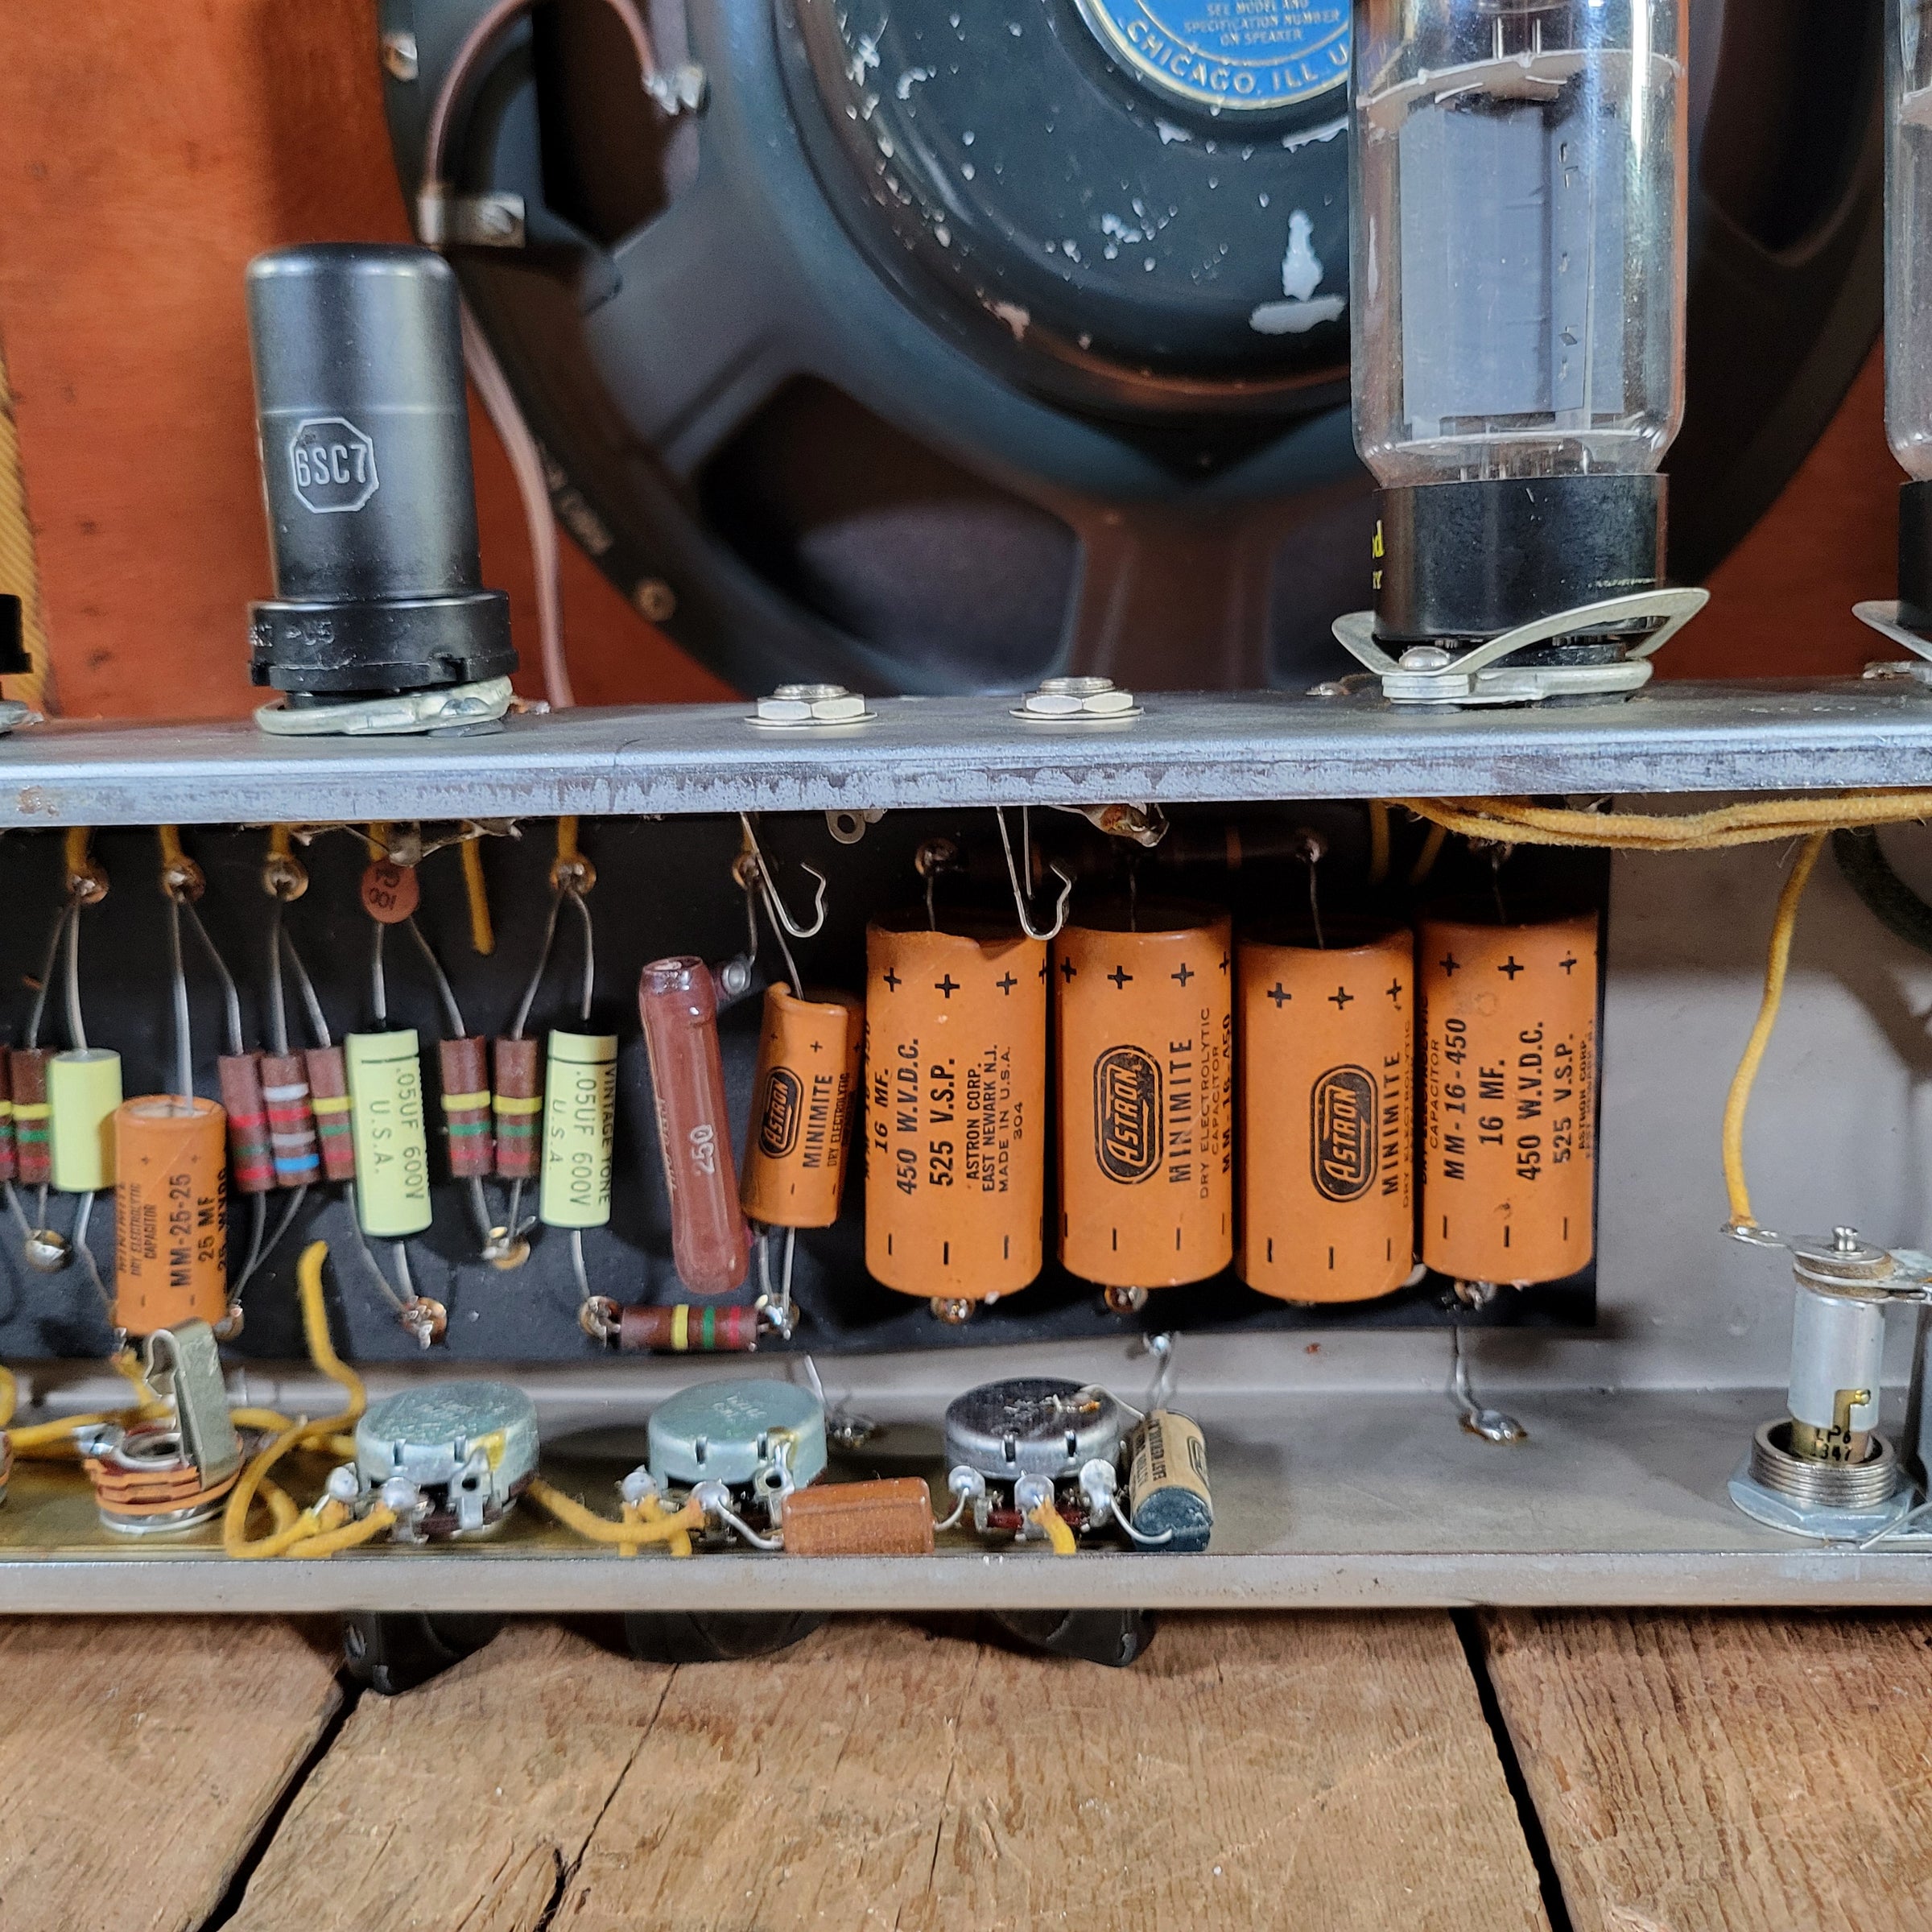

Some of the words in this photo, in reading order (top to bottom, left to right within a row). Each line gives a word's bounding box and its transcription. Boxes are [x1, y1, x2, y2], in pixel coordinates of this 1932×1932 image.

[1220, 33, 1240, 46] ON
[1244, 28, 1302, 43] SPEAKER
[1285, 8, 1340, 25] NUMBER
[295, 444, 368, 488] 6SC7
[874, 1068, 889, 1108] MF.
[897, 1038, 919, 1133] W.V.D.C.
[930, 1058, 956, 1124] V.S.P.
[967, 1063, 982, 1111] CORP.
[1200, 1007, 1211, 1152] ELECTROLYTIC
[1430, 1038, 1439, 1150] CAPACITOR
[1479, 1059, 1505, 1100] MF.
[1517, 1021, 1544, 1120] W.V.D.C.
[1554, 1034, 1574, 1102] V.S.P.
[764, 1077, 793, 1150] ASTRON
[803, 1075, 833, 1167] MINIMITE
[831, 1072, 850, 1144] ELECTROLYTIC
[982, 1080, 997, 1146] NEWARK
[999, 1110, 1009, 1131] IN
[1013, 1101, 1023, 1141] 304
[1106, 1063, 1150, 1168] ASTRON
[1169, 1038, 1192, 1184] MINIMITE
[1212, 1046, 1220, 1156] CAPACITOR
[1381, 1051, 1401, 1196] MINIMITE
[1578, 1090, 1587, 1150] ASTRON
[875, 1120, 889, 1154] 16
[966, 1118, 980, 1180] ASTRON
[1323, 1084, 1369, 1184] ASTRON
[1478, 1116, 1504, 1146] 16
[1516, 1134, 1542, 1181] 450
[1553, 1117, 1571, 1164] 525
[402, 1146, 425, 1199] 600V
[569, 1151, 593, 1207] 600V
[598, 1156, 612, 1207] TONE
[896, 1148, 918, 1195] 450
[929, 1140, 954, 1187] 525
[982, 1154, 996, 1192] EAST
[998, 1139, 1009, 1193] MADE
[1200, 1162, 1210, 1199] DRY
[143, 1204, 157, 1260] CAPACITOR
[169, 1173, 192, 1288] MM-25-25
[197, 1196, 216, 1228] MF
[197, 1236, 215, 1263] 25
